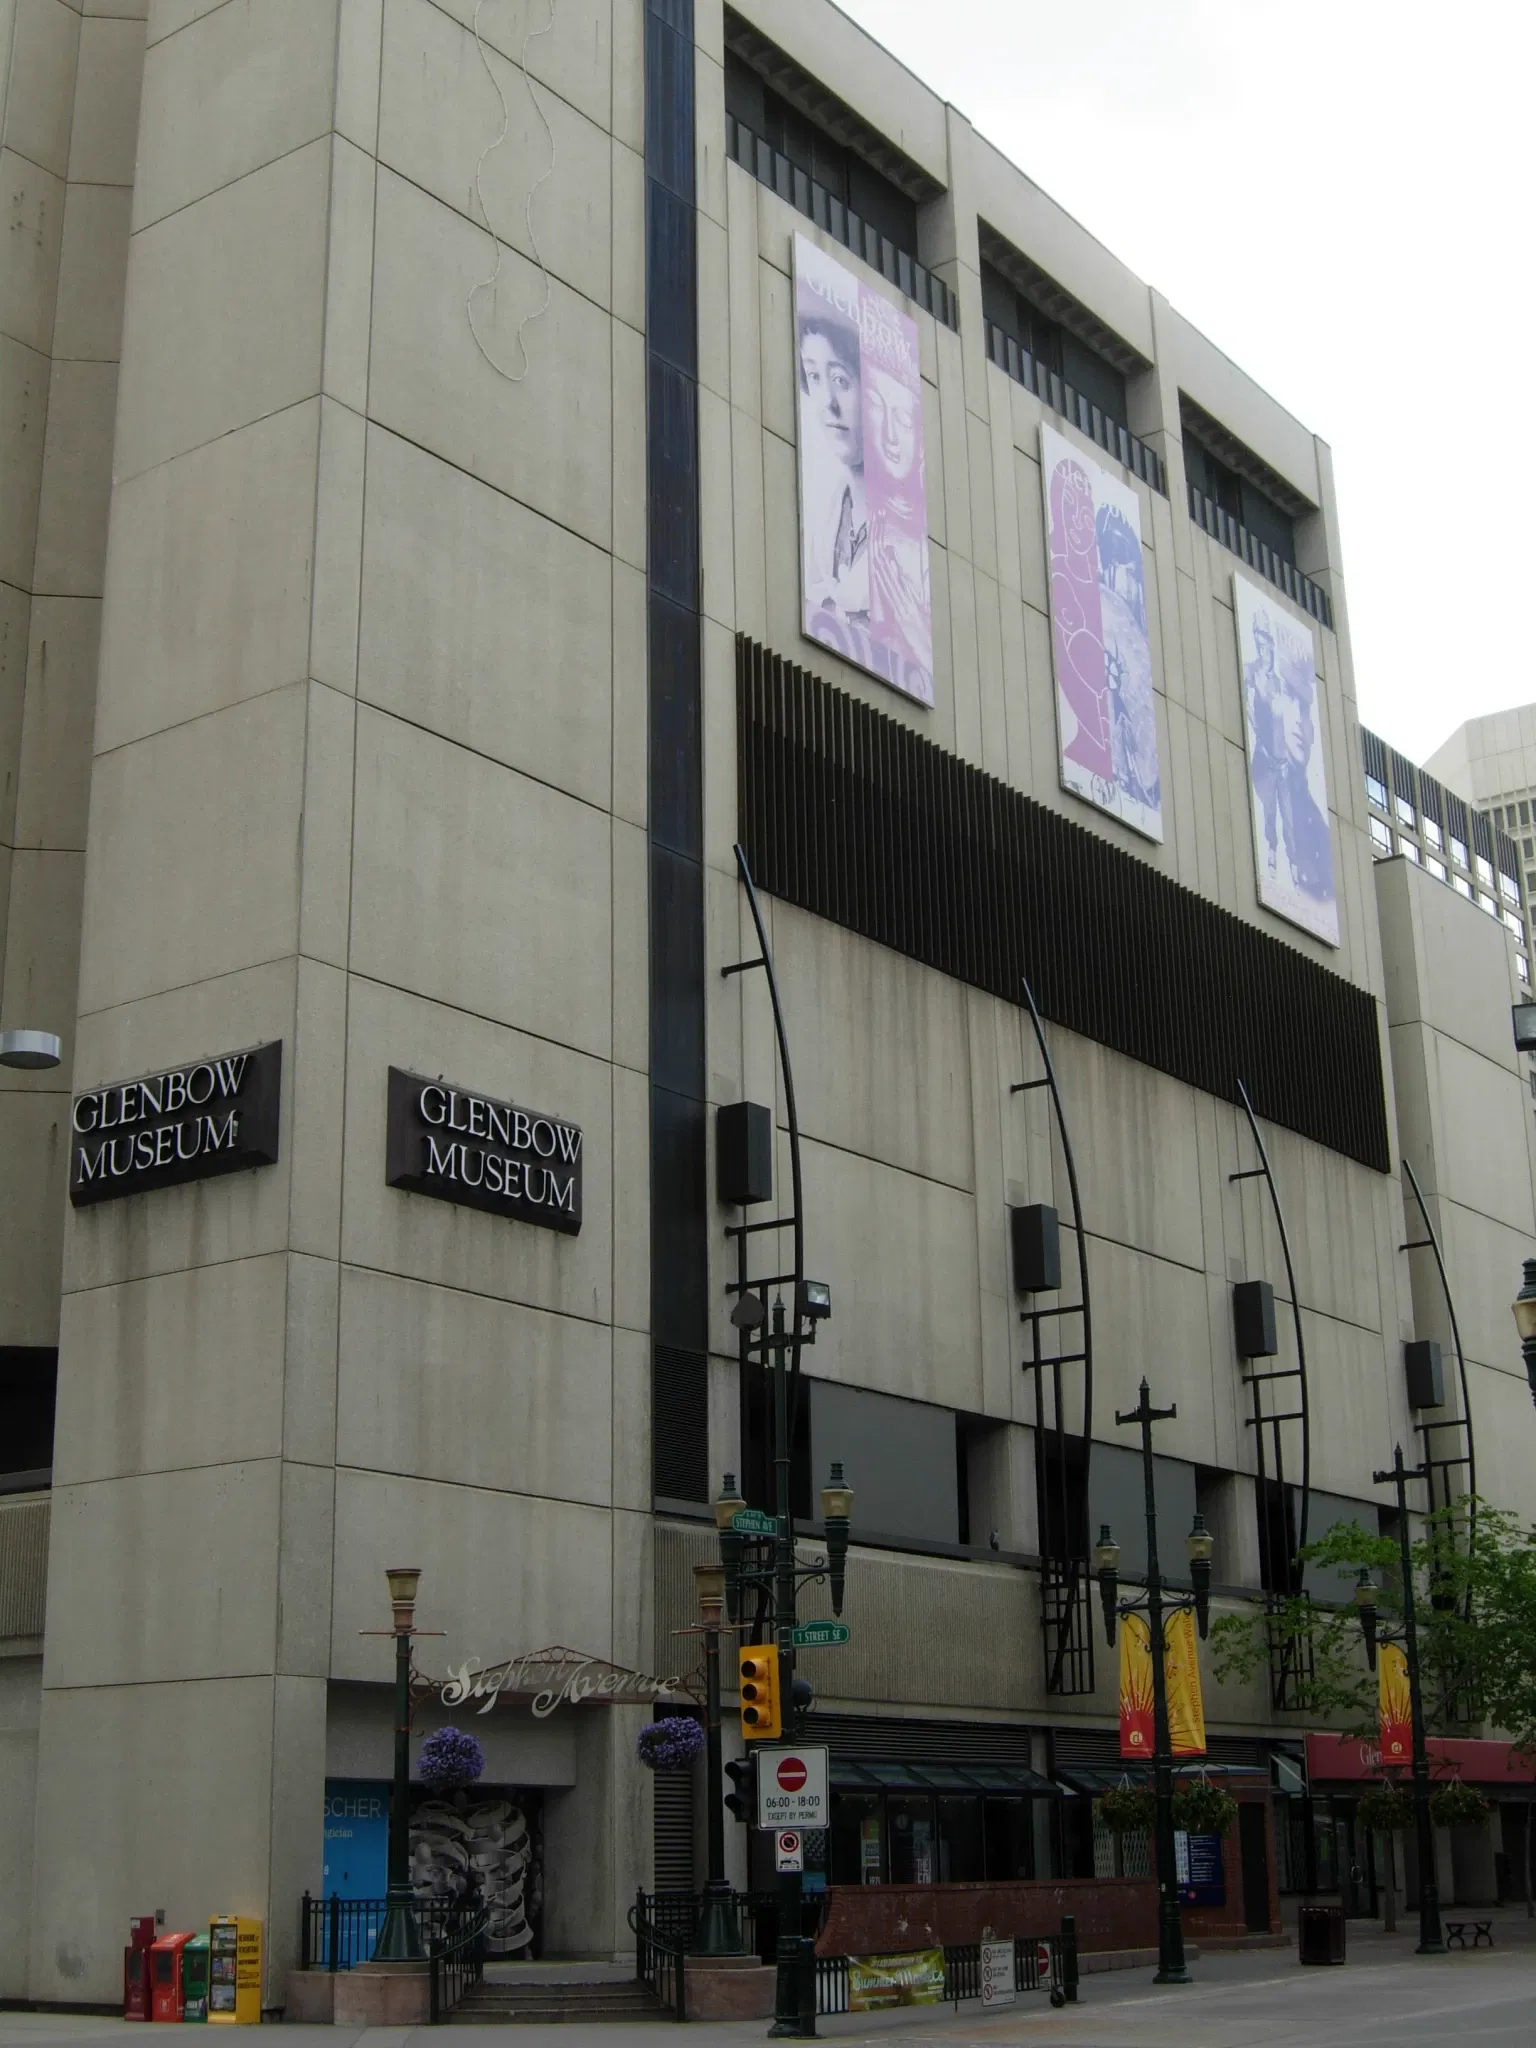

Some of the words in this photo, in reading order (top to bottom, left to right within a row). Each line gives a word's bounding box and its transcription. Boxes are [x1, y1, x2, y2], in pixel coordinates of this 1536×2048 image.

[73, 1054, 251, 1133] GLENBOW
[419, 1085, 582, 1165] GLENBOW
[76, 1109, 236, 1184] MUSEUM
[426, 1135, 575, 1212] MUSEUM
[736, 1517, 760, 1530] STEPHEN
[762, 1520, 773, 1532] AVE
[798, 1632, 802, 1642] 1
[804, 1630, 830, 1642] STREET
[832, 1629, 841, 1640] SE
[1186, 1640, 1197, 1680] Avenue
[441, 1652, 568, 1714] Stephen
[532, 1659, 680, 1718] Avenue
[1360, 1743, 1384, 1765] Glen
[324, 1796, 381, 1818] SCHER
[766, 1796, 790, 1808] 06:00
[798, 1796, 821, 1806] 18:00
[768, 1811, 787, 1821] EXCEPT
[789, 1811, 796, 1820] BY
